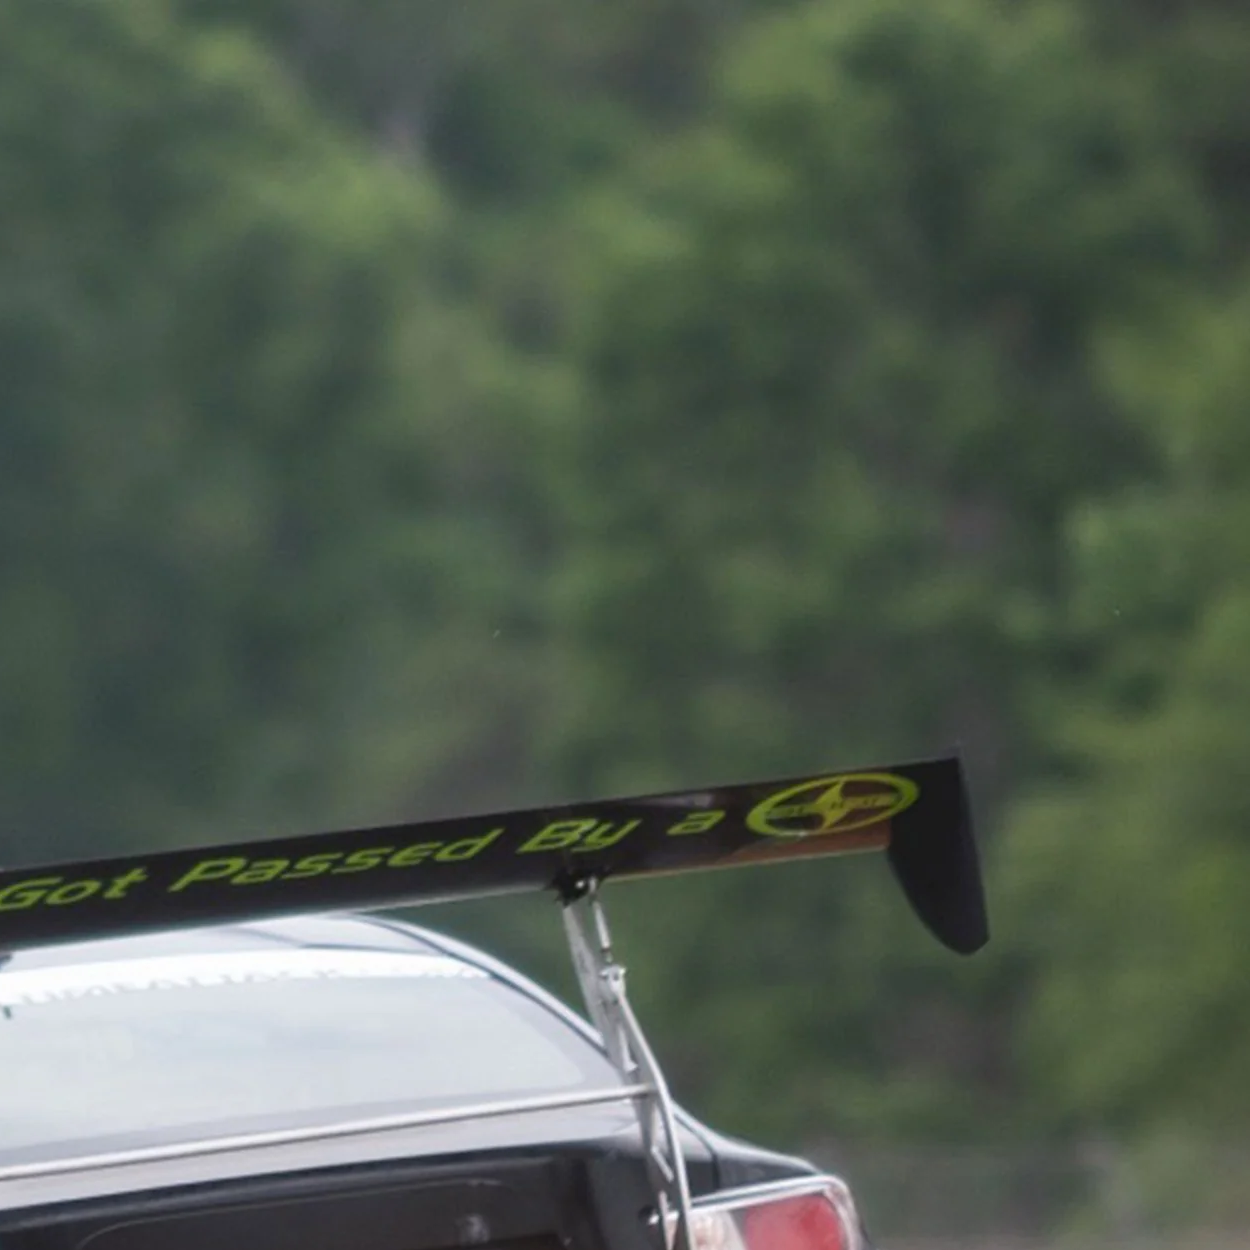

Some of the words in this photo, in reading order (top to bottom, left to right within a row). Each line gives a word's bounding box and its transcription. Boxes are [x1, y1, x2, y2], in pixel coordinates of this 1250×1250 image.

[170, 828, 502, 892] Passed
[519, 817, 640, 854] By
[667, 810, 726, 836] a
